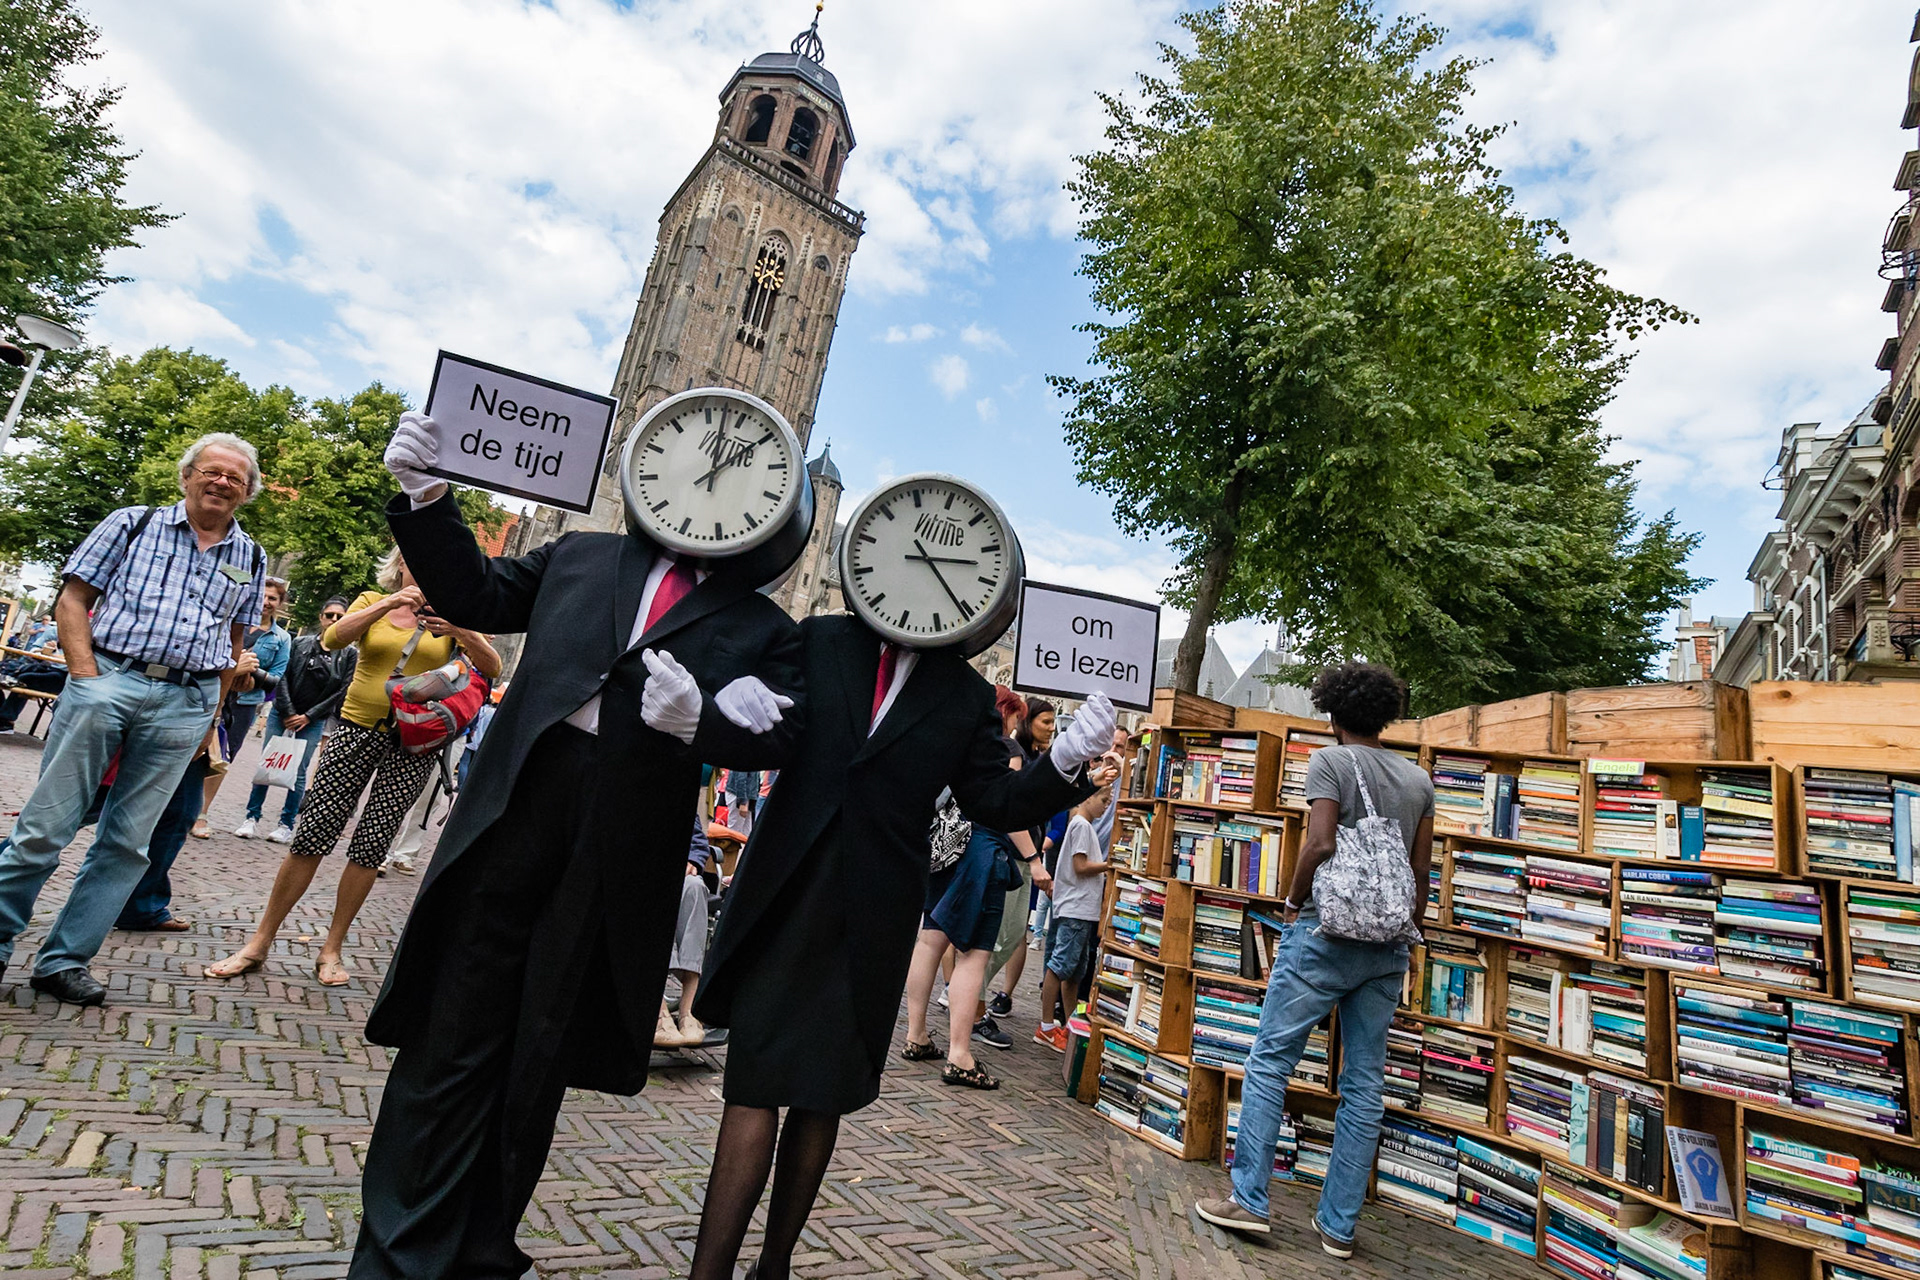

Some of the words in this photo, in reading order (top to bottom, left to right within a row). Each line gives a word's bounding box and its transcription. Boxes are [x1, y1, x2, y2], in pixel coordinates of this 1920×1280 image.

[469, 383, 572, 438] Neem
[459, 428, 503, 461] de
[514, 441, 564, 479] tijd
[1071, 616, 1113, 640] om
[1034, 643, 1061, 670] te
[1071, 647, 1139, 684] lezen
[262, 752, 293, 771] H&M
[1594, 761, 1637, 774] Engels
[1622, 870, 1647, 880] HARLAN
[1648, 871, 1670, 881] COBEN
[1623, 893, 1635, 901] IAN
[1636, 894, 1662, 904] RANKIN
[1771, 937, 1787, 945] DARK
[1787, 938, 1807, 947] BLOOD
[1717, 946, 1733, 954] STATE
[1742, 950, 1776, 961] EMERGENCY
[1702, 1082, 1710, 1090] IN
[1710, 1083, 1737, 1095] SEARCH
[1737, 1088, 1747, 1097] OF
[1747, 1090, 1779, 1104] ENEMIES
[1383, 1138, 1403, 1152] PETER
[1404, 1145, 1439, 1164] ROBINSON
[1668, 1129, 1680, 1163] REVOLUTION
[1677, 1133, 1718, 1149] REVOLUTION
[1764, 1139, 1816, 1161] Virolution
[1392, 1165, 1437, 1190] FIASCO
[1677, 1174, 1688, 1199] EJERSBO
[1694, 1200, 1710, 1211] JAKOB
[1710, 1204, 1732, 1215] EJERSBO
